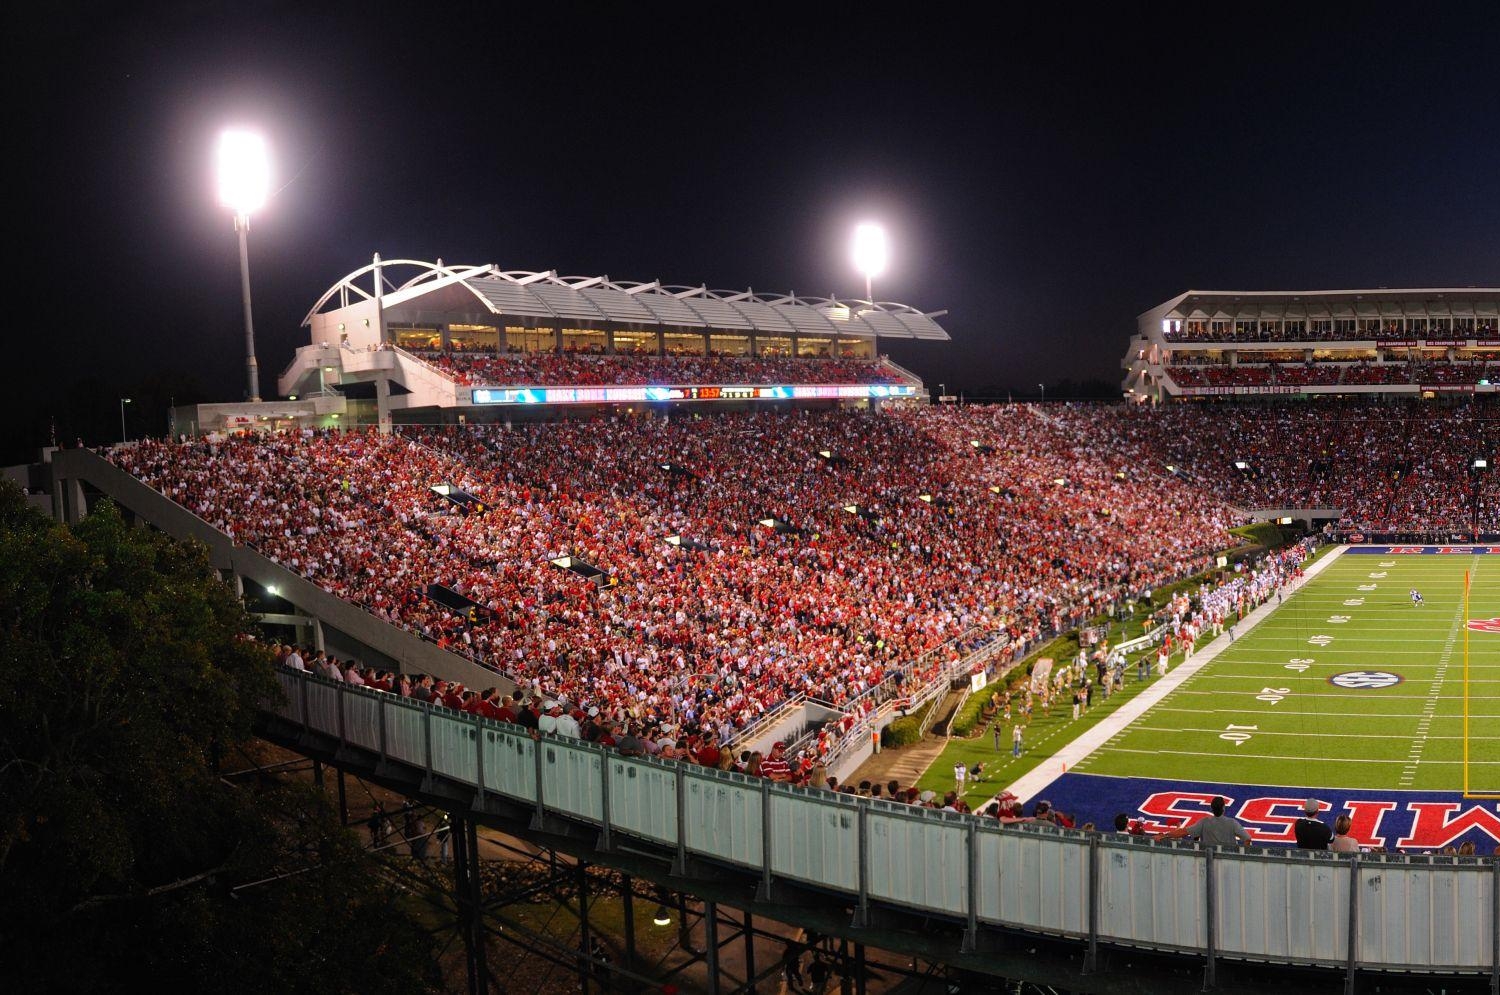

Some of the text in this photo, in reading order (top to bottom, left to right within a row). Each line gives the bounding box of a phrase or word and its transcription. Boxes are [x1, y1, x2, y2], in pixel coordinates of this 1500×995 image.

[700, 388, 720, 397] 13:57
[1284, 658, 1316, 670] 30
[1256, 687, 1291, 702] 20
[1218, 724, 1258, 740] 10
